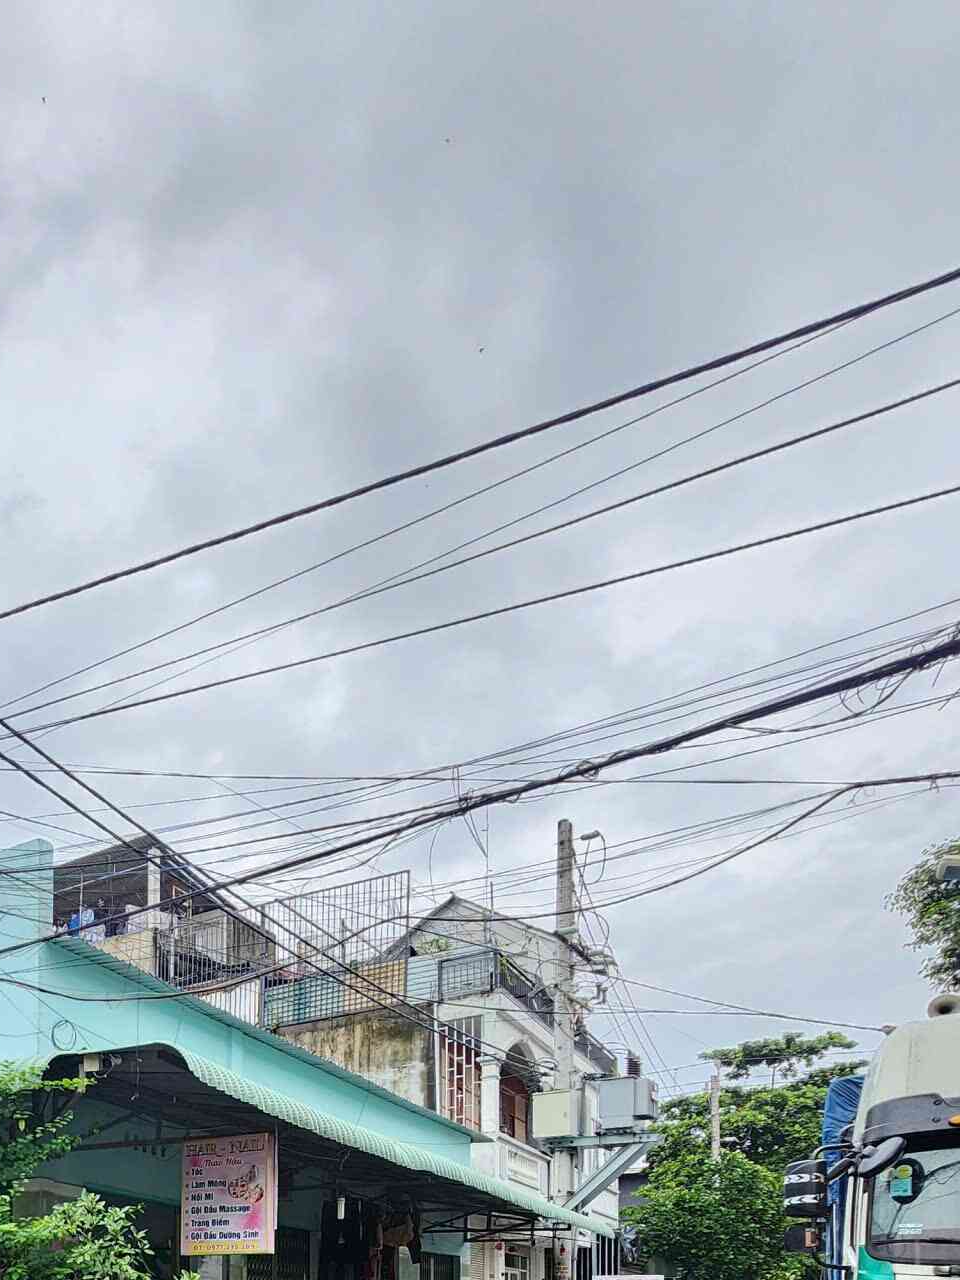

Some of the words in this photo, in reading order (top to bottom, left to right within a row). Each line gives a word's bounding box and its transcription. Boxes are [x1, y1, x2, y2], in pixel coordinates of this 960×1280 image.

[191, 1206, 202, 1216] Gội
[219, 1205, 251, 1214] Massage
[191, 1219, 210, 1228] Trang
[191, 1231, 202, 1241] Gội
[243, 1230, 259, 1238] Sinh
